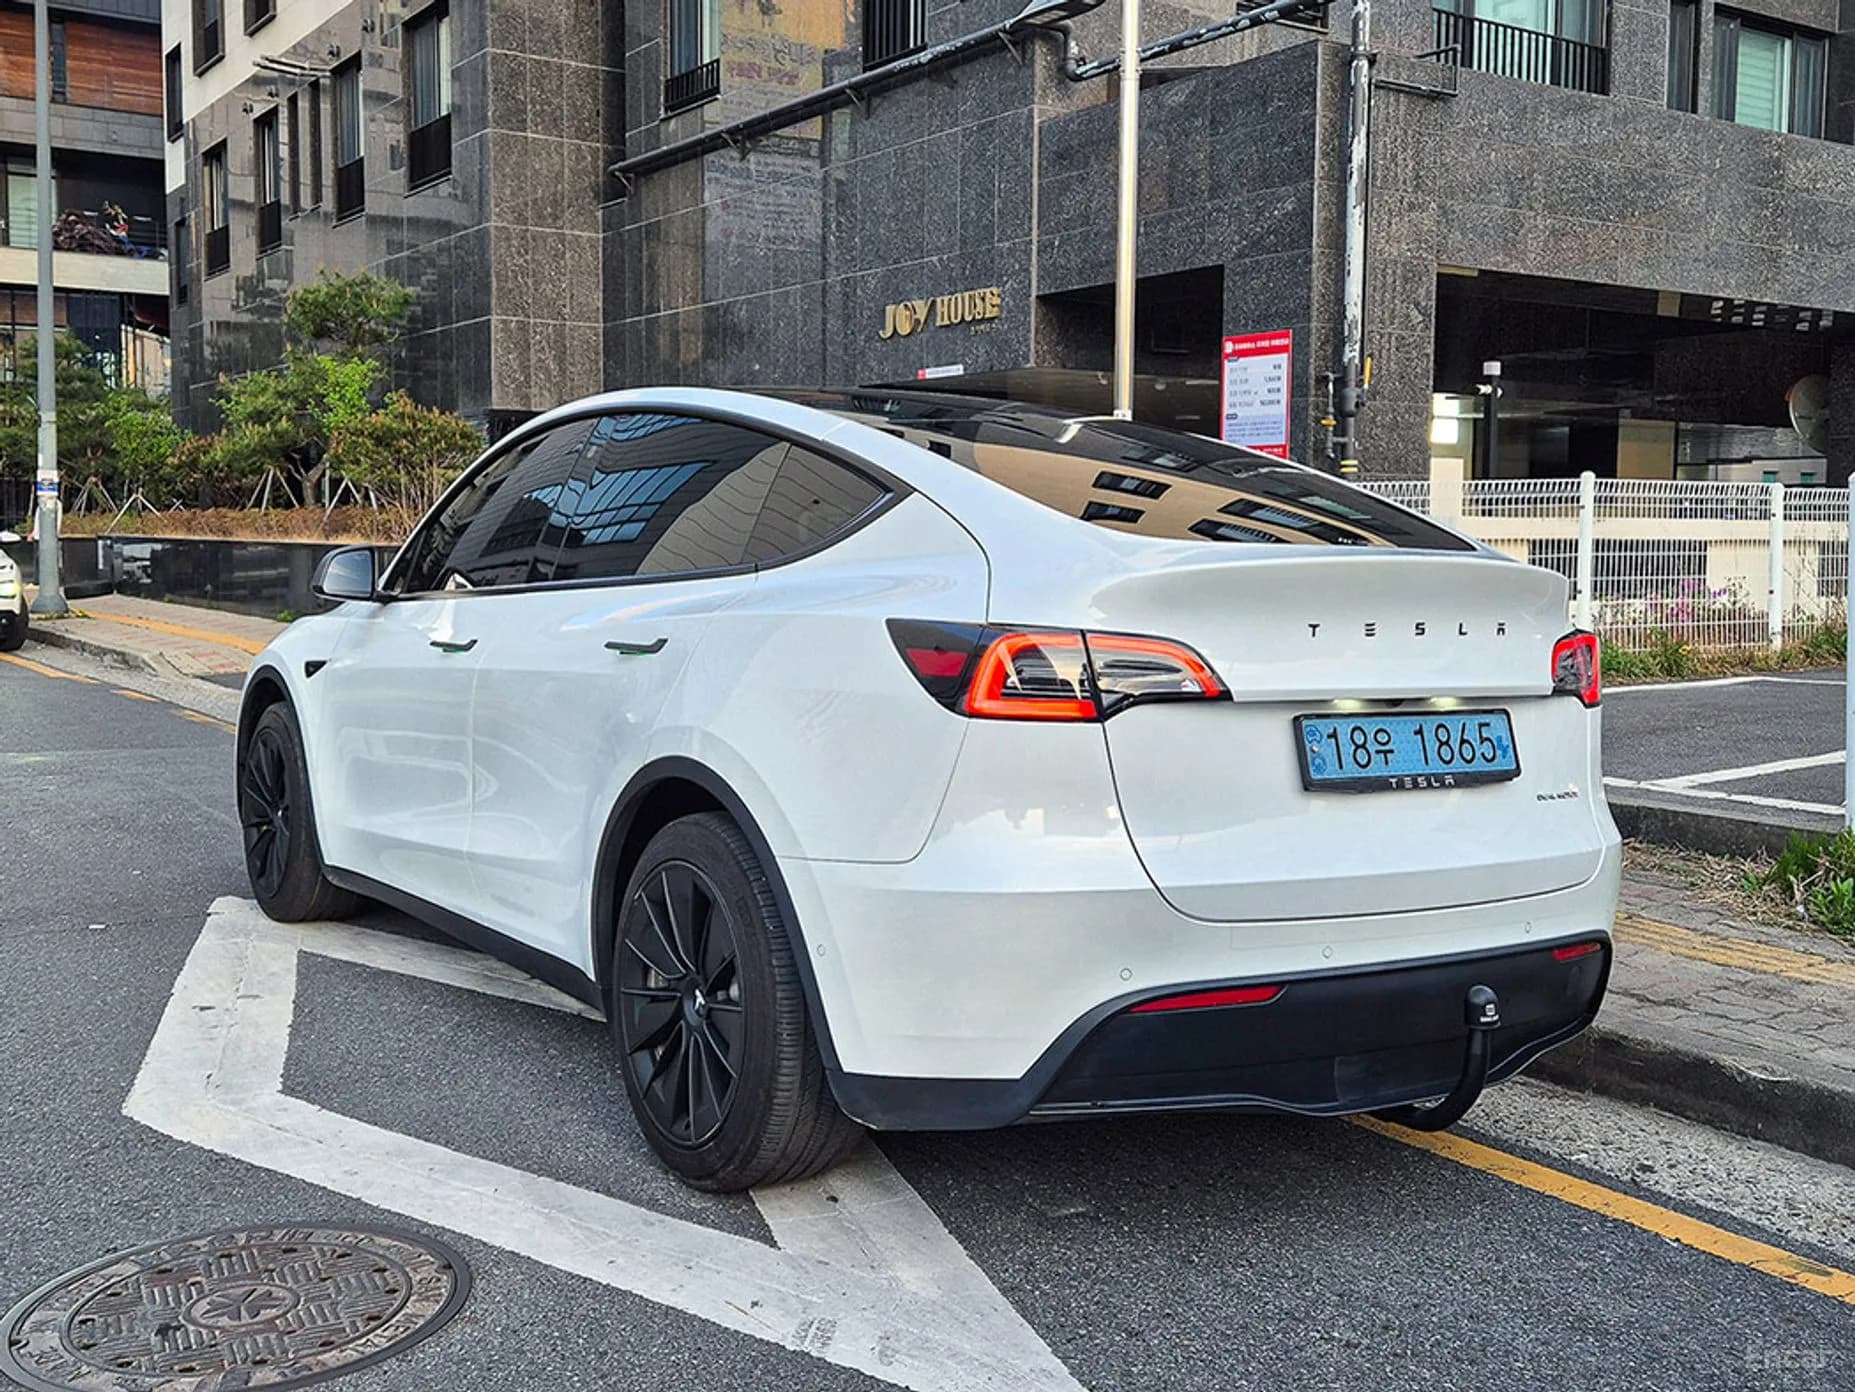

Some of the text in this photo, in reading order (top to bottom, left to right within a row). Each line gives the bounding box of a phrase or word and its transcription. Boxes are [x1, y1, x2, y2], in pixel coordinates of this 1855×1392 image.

[879, 287, 1002, 339] JOY HOUSE
[1308, 622, 1506, 638] TESLA
[1326, 721, 1497, 770] 18우 1865
[1389, 775, 1455, 789] TESLA
